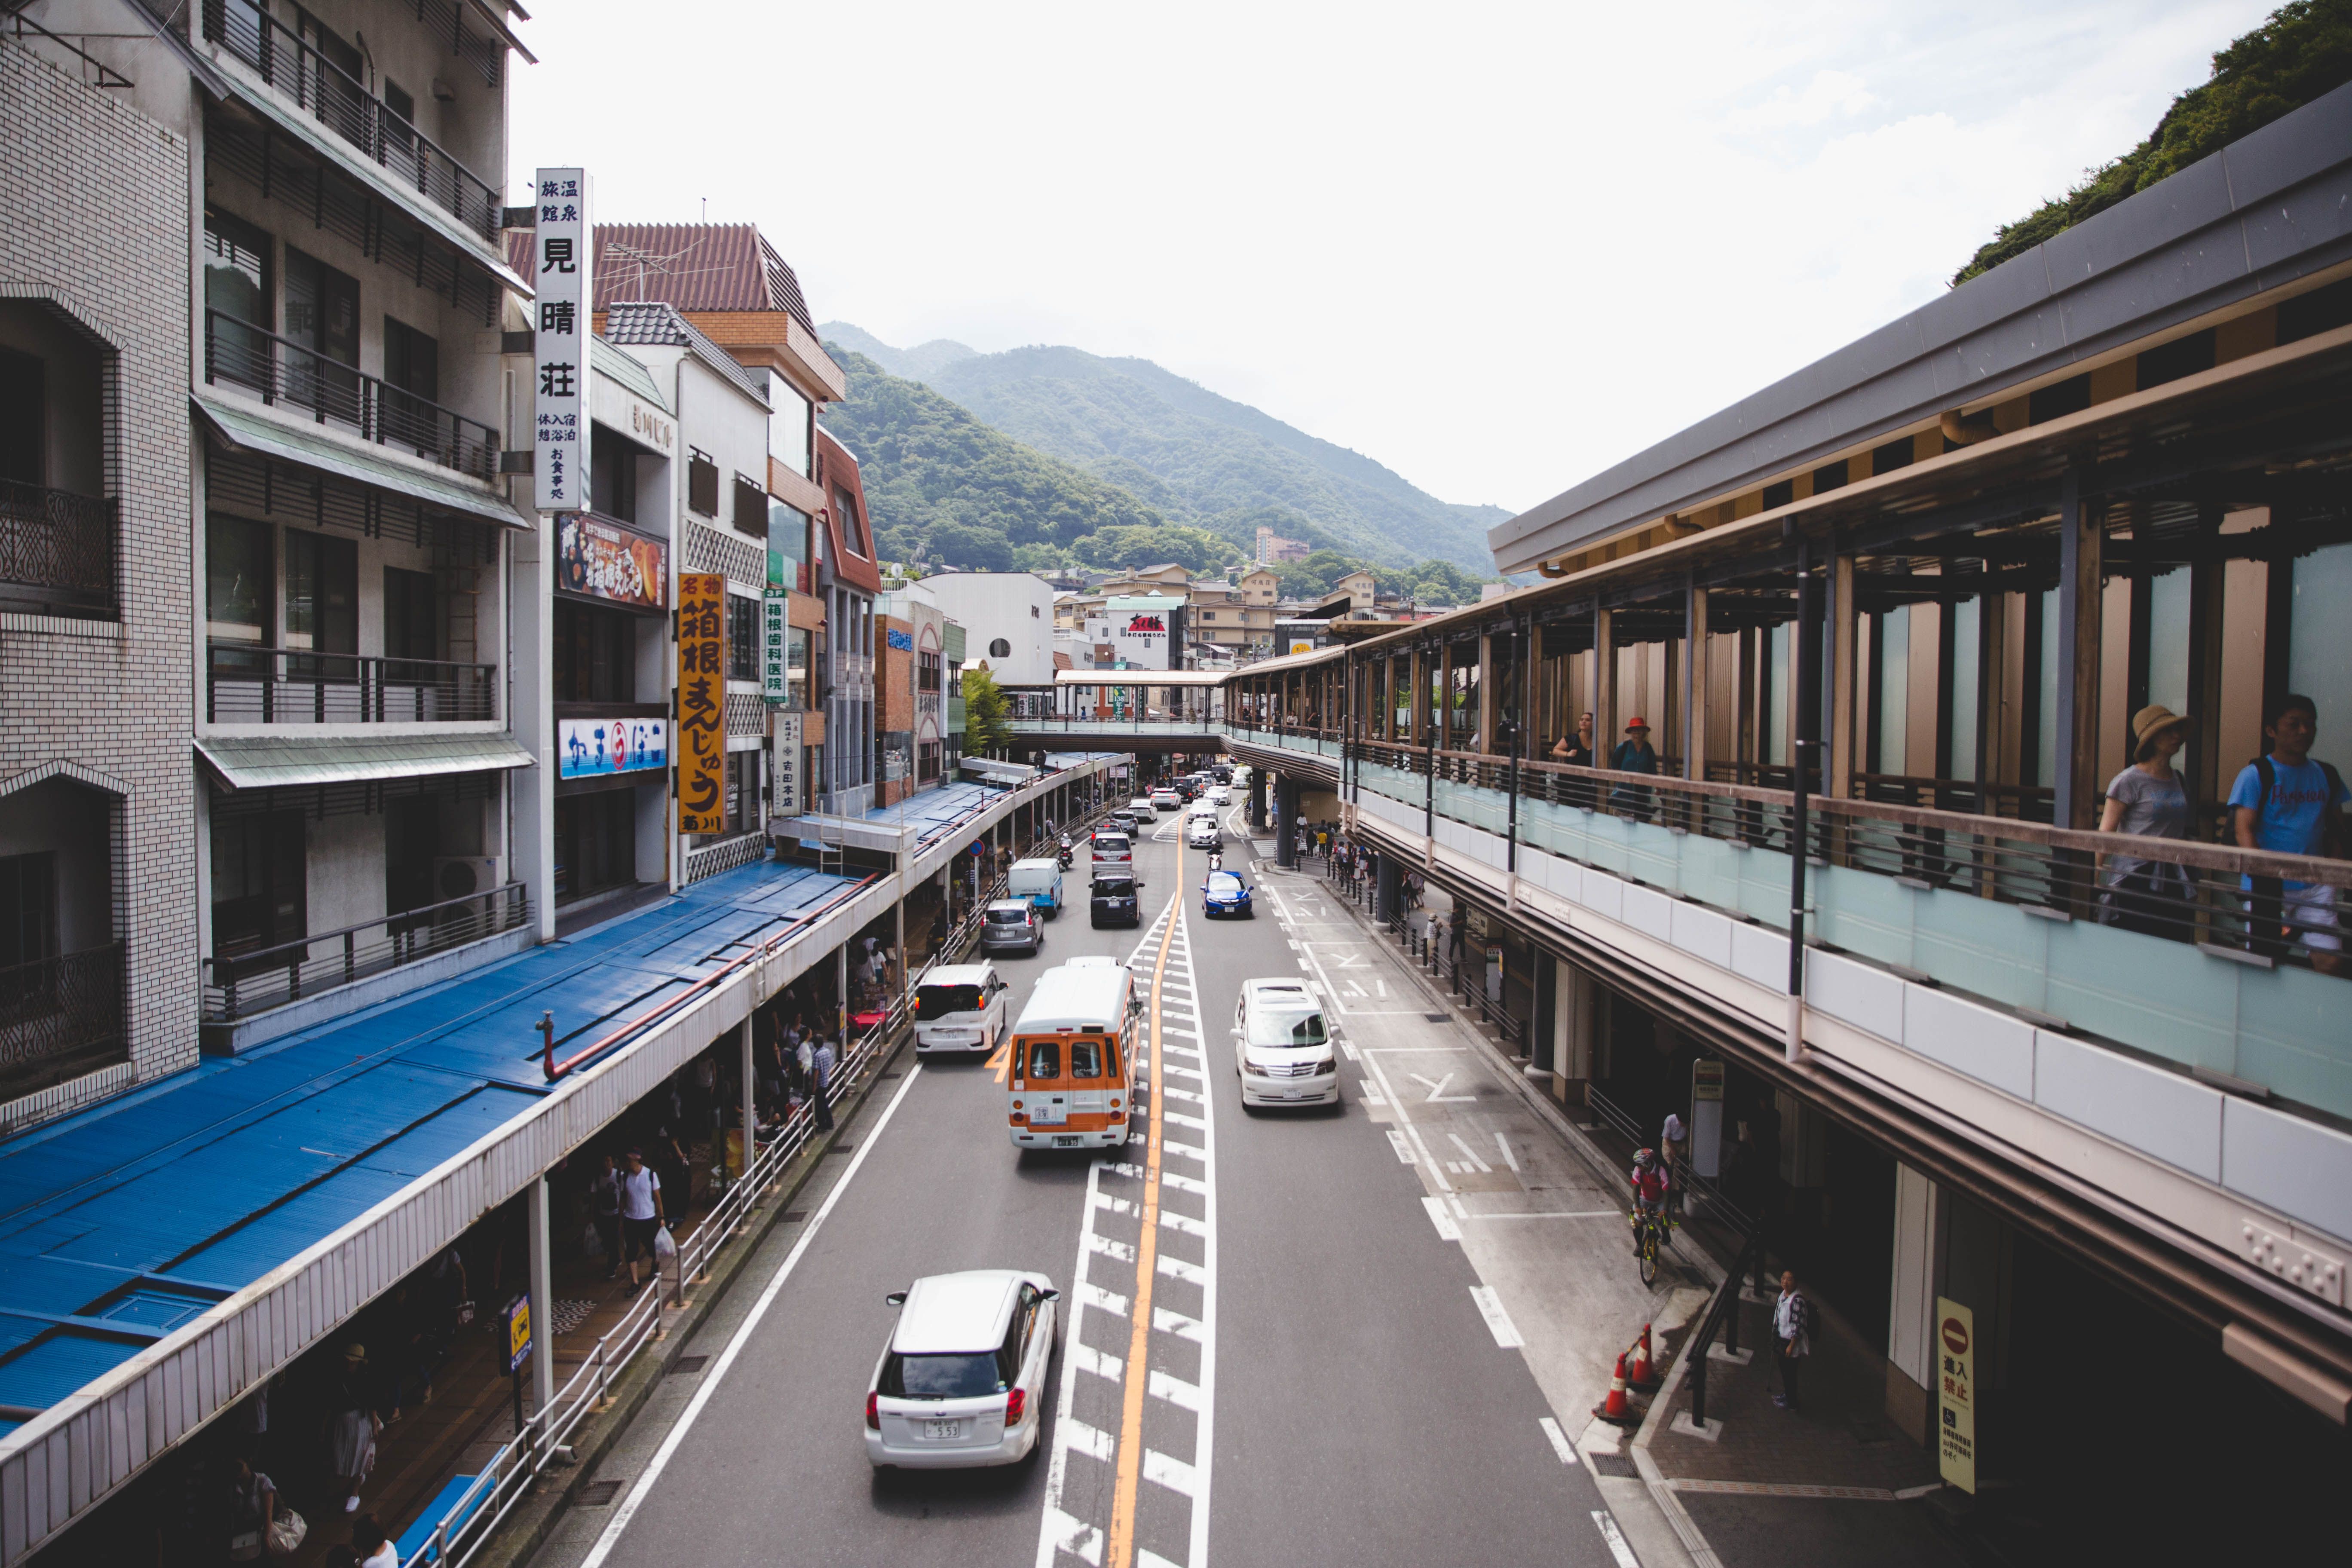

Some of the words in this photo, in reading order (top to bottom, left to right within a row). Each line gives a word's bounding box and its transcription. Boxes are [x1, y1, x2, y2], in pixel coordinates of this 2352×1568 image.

[541, 181, 558, 223] 旅館
[560, 180, 578, 222] 温泉
[541, 238, 576, 398] 見晴荘
[538, 413, 551, 442] 休憩
[551, 413, 564, 441] 入浴
[564, 413, 576, 441] 宿泊
[551, 449, 564, 499] お食事処
[682, 577, 721, 594] 名物
[767, 603, 782, 691] 箱根歯科医院
[682, 599, 722, 813] 箱根まんじゅう
[782, 760, 794, 807] 吉田本店
[682, 815, 721, 832] 菊川
[1943, 1354, 1968, 1380] 進入
[1944, 1376, 1968, 1402] 禁止
[1943, 1449, 1957, 1462] のぞく
